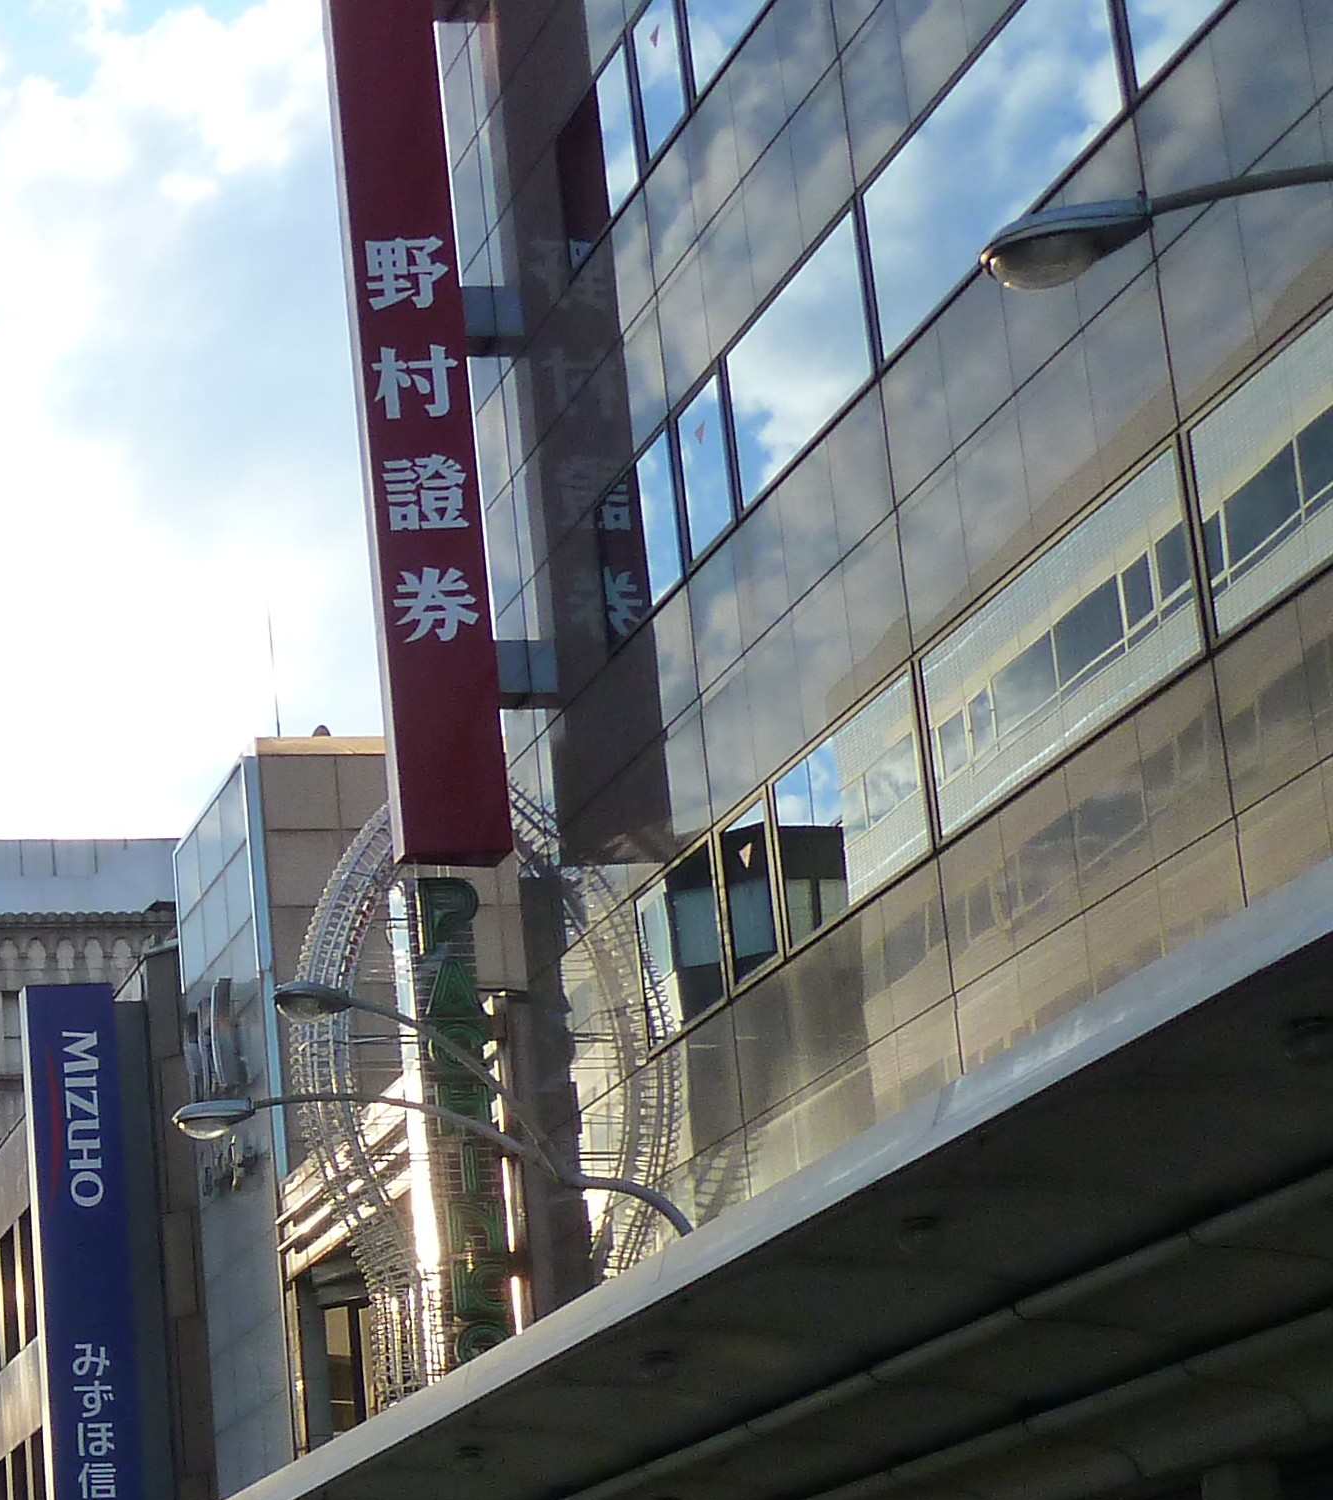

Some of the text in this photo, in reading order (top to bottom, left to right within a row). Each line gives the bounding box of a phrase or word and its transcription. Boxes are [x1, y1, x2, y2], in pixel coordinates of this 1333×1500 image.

[365, 236, 479, 642] 野村證券
[61, 1030, 104, 1208] MIZUHO
